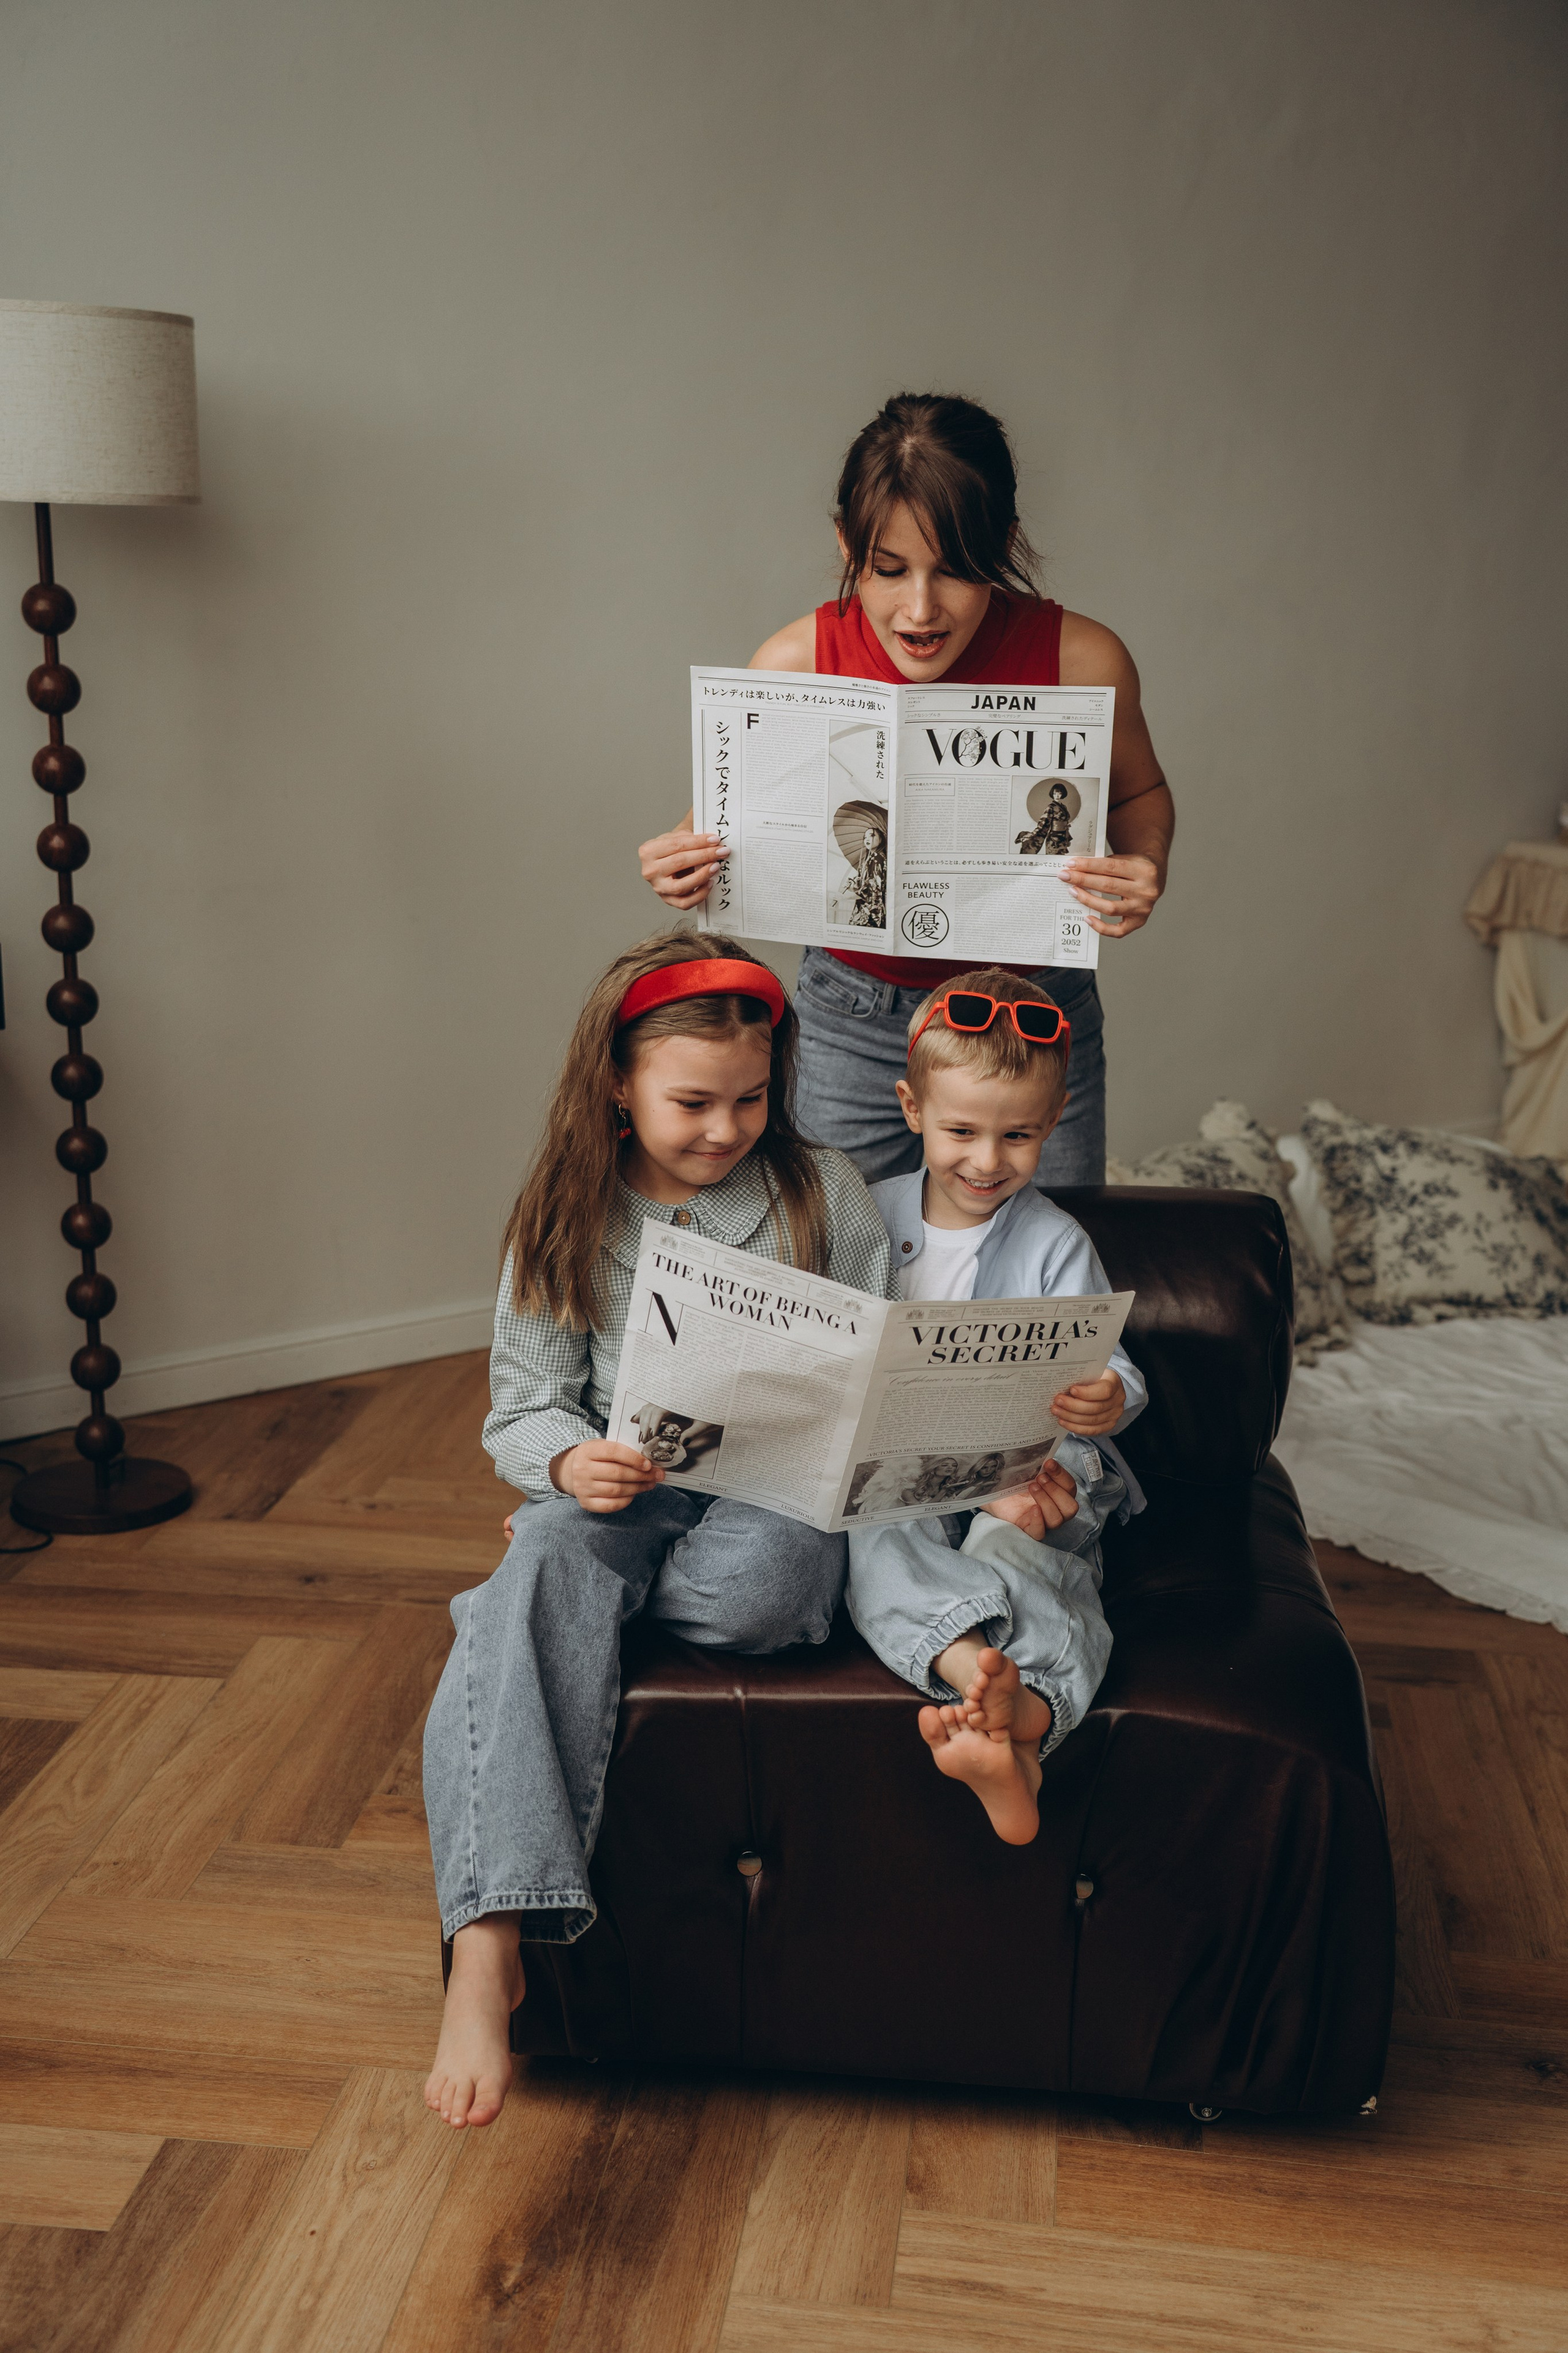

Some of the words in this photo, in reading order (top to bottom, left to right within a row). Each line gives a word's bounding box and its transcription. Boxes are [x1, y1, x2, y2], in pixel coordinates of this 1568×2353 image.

[704, 686, 886, 711] トレンディは楽しいが、タイムレスは力強い
[971, 695, 1036, 711] JAPAN
[747, 713, 759, 729] F
[876, 730, 886, 779] 洗練された
[922, 728, 1086, 769] VOGUE
[715, 721, 731, 911] シックでタイムレなルック
[908, 910, 940, 940] 優
[1062, 923, 1081, 936] 30
[652, 1252, 693, 1281] THE
[696, 1271, 740, 1296] ART
[743, 1287, 772, 1305] OF
[775, 1296, 840, 1329] BEING
[843, 1321, 858, 1335] A
[638, 1288, 690, 1346] N
[708, 1291, 794, 1331] WOMAN
[909, 1320, 1098, 1345] VICTORIA's
[927, 1342, 1068, 1364] SECRET
[889, 1375, 940, 1386] Confidence
[983, 1372, 1015, 1380] detail
[699, 1482, 728, 1492] ELEGANT
[781, 1504, 815, 1521] LUXURIOUS
[841, 1516, 875, 1525] SEDUCTIVE
